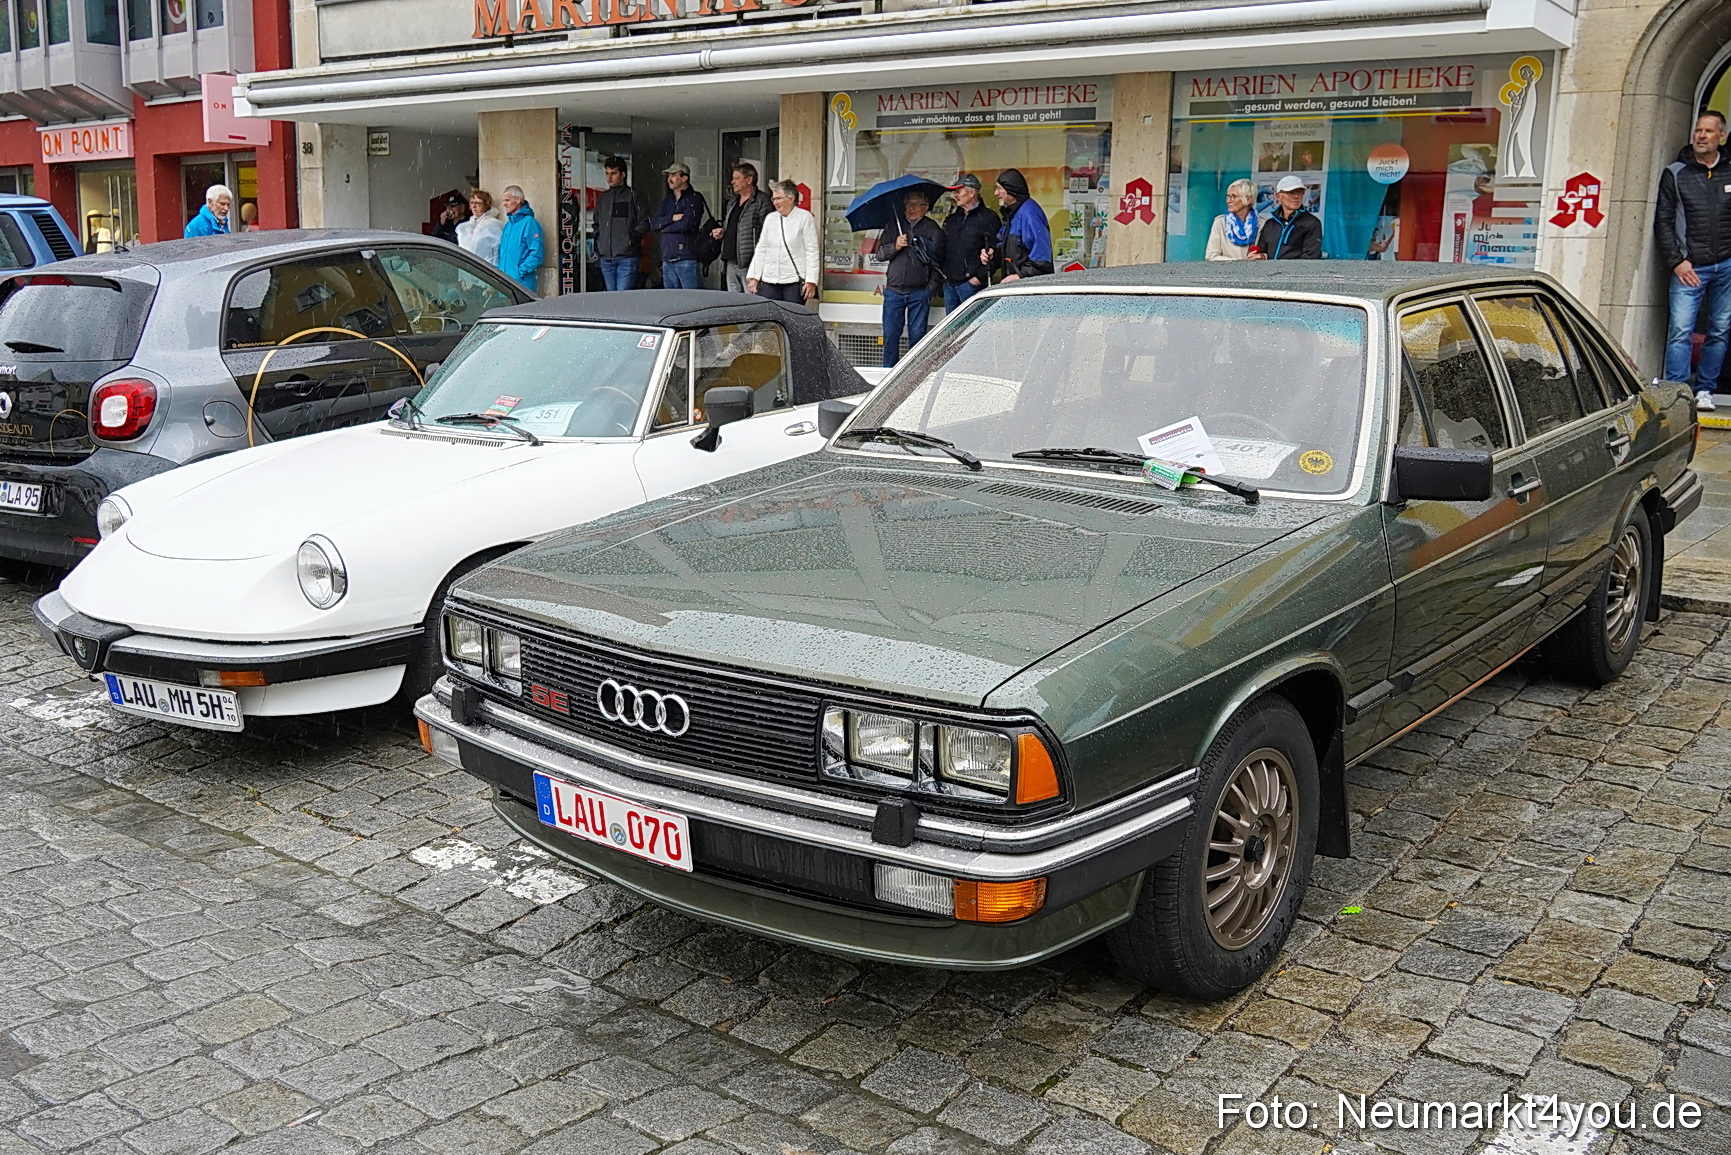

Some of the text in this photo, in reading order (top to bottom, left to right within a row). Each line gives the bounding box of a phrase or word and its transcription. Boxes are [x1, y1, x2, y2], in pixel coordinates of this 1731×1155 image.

[1190, 64, 1475, 98] MARIEN APOTHEKE
[213, 102, 227, 110] ON
[876, 83, 1098, 112] MARIEN APOTHEKE
[1235, 95, 1417, 114] ...gesund werden, gesund bleiben!
[926, 113, 963, 124] möchten,
[964, 113, 984, 123] dass
[985, 113, 995, 122] es
[997, 111, 1021, 121] Ihnen
[1023, 111, 1036, 122] gut
[1037, 110, 1061, 122] geht!
[43, 126, 122, 156] ON POINT
[561, 123, 574, 205] MARIEN
[1379, 170, 1400, 178] nicht!
[536, 408, 560, 419] 351
[7, 484, 40, 508] LA 95
[119, 679, 225, 720] LAU MH 5H
[227, 713, 236, 722] 10
[543, 804, 550, 816] D
[554, 786, 682, 862] LAU 070
